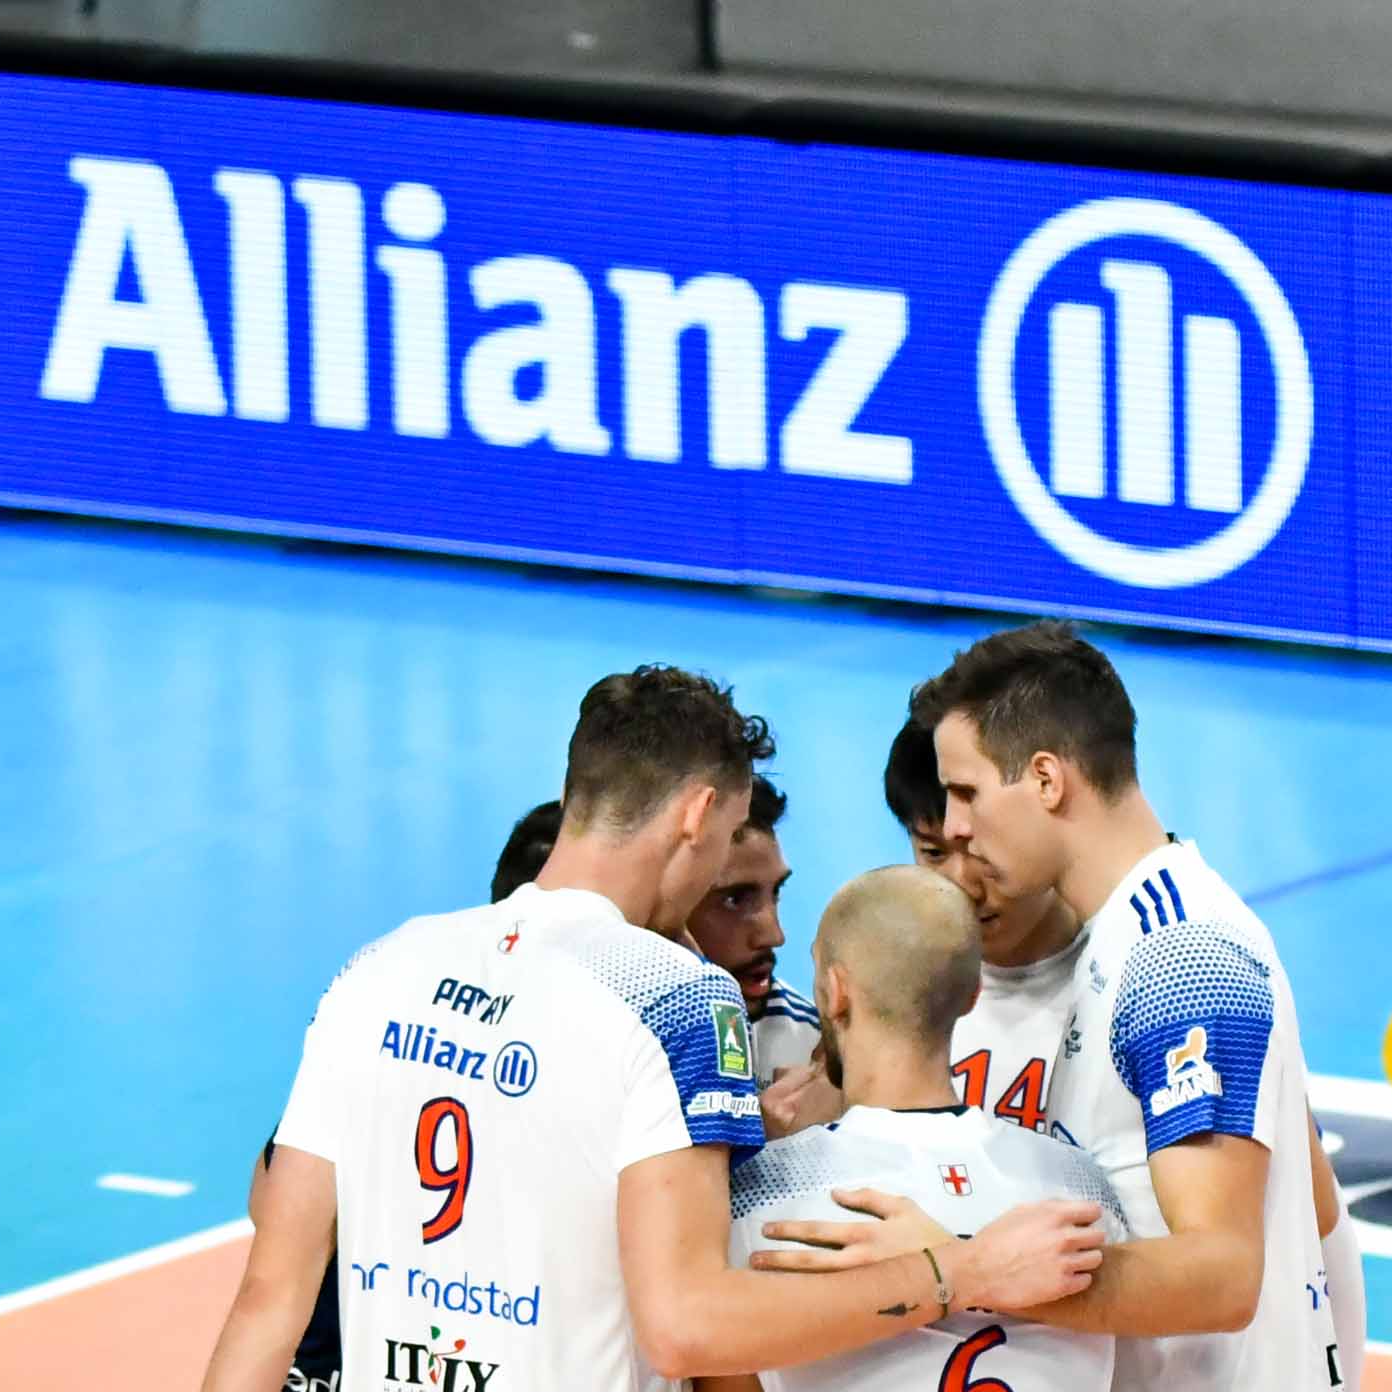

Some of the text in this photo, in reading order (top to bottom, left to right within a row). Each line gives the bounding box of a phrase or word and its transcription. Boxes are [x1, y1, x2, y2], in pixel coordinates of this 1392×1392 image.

[41, 155, 914, 484] Allianz
[950, 1048, 1048, 1133] 14
[414, 1096, 474, 1246] 9
